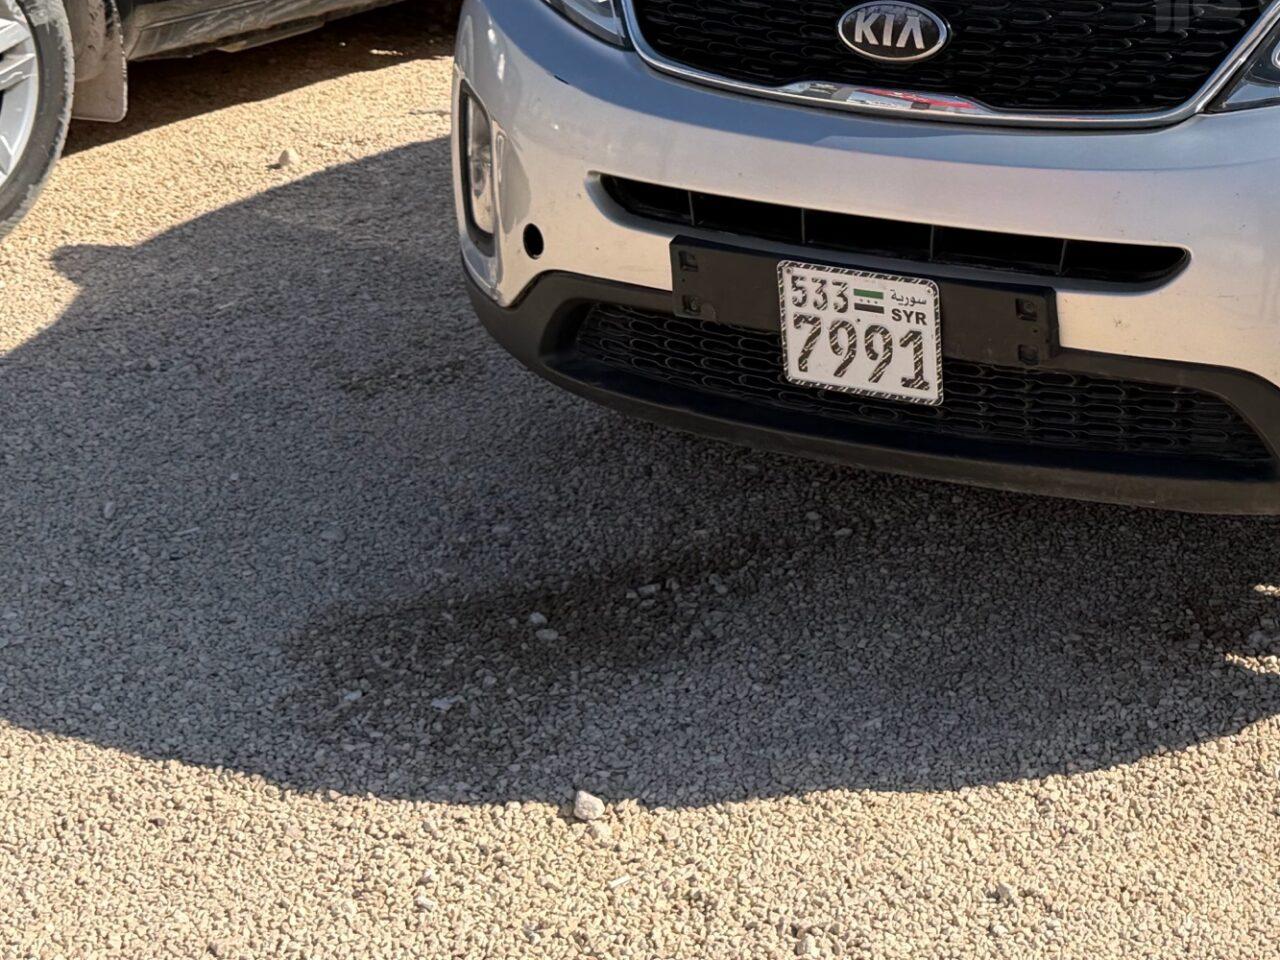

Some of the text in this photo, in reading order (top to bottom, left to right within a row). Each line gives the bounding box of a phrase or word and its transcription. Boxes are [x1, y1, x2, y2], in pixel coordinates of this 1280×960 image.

[854, 11, 925, 49] KIA
[791, 275, 849, 314] 533
[890, 289, 928, 306] سورية
[891, 308, 928, 326] SYR
[793, 313, 930, 391] 7991
